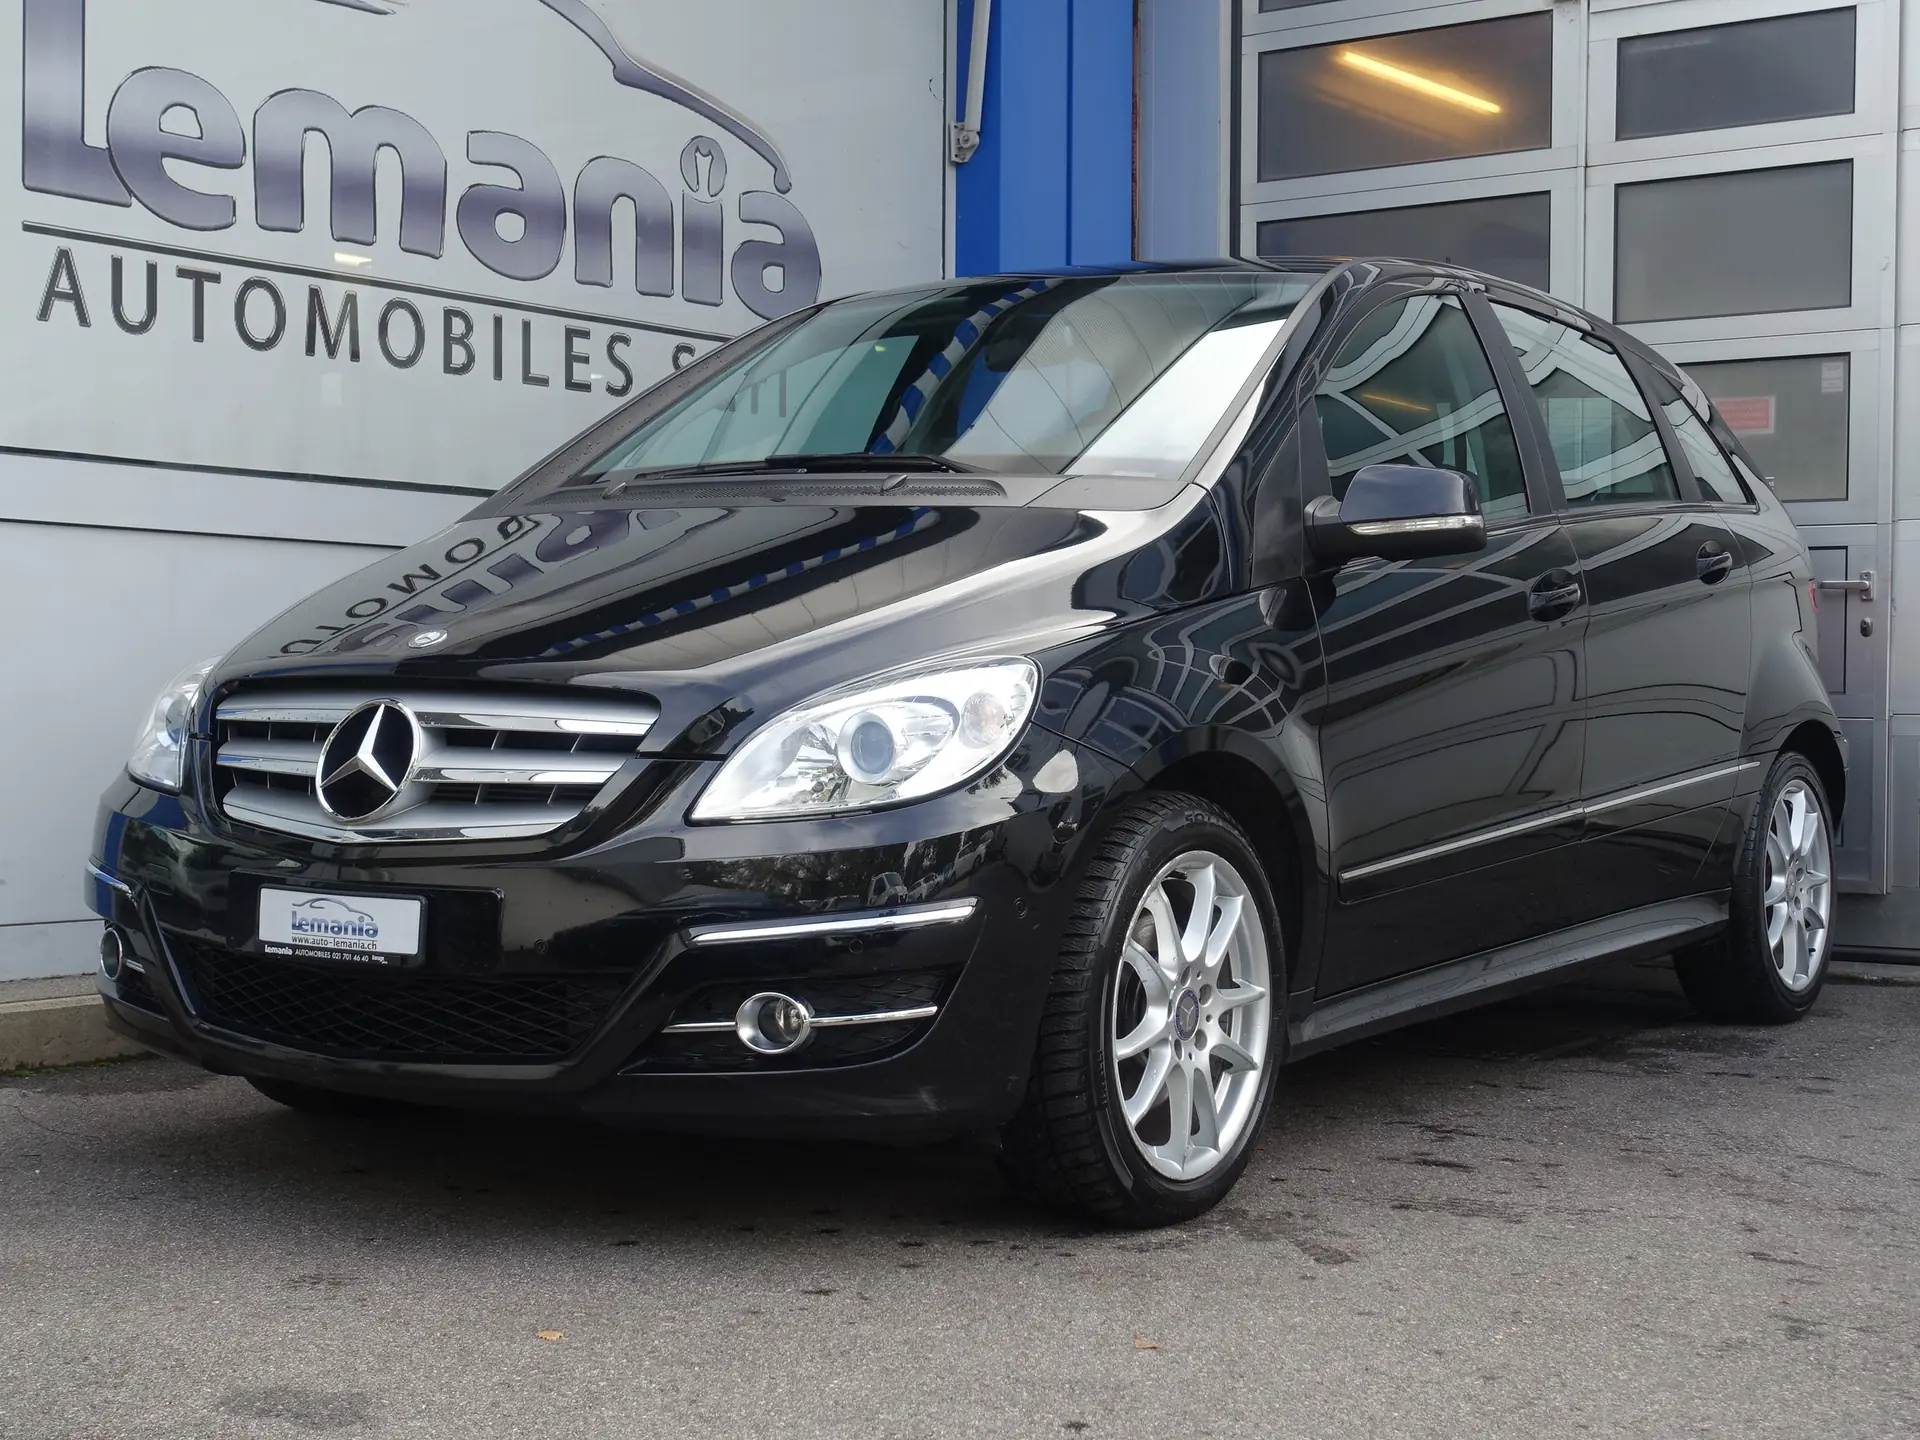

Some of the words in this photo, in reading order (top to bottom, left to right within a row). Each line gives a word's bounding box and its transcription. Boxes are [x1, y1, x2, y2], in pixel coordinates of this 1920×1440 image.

[22, 0, 822, 320] Lemania
[36, 246, 633, 397] AUTOMOBILES
[291, 911, 379, 938] Lemania
[264, 945, 293, 955] Lemania
[295, 949, 331, 959] AUTOMOBILES
[332, 952, 342, 960] 021
[342, 953, 352, 961] 701
[353, 954, 361, 962] 46
[361, 955, 369, 963] 40
[292, 935, 377, 950] www.auto-lemania.ch
